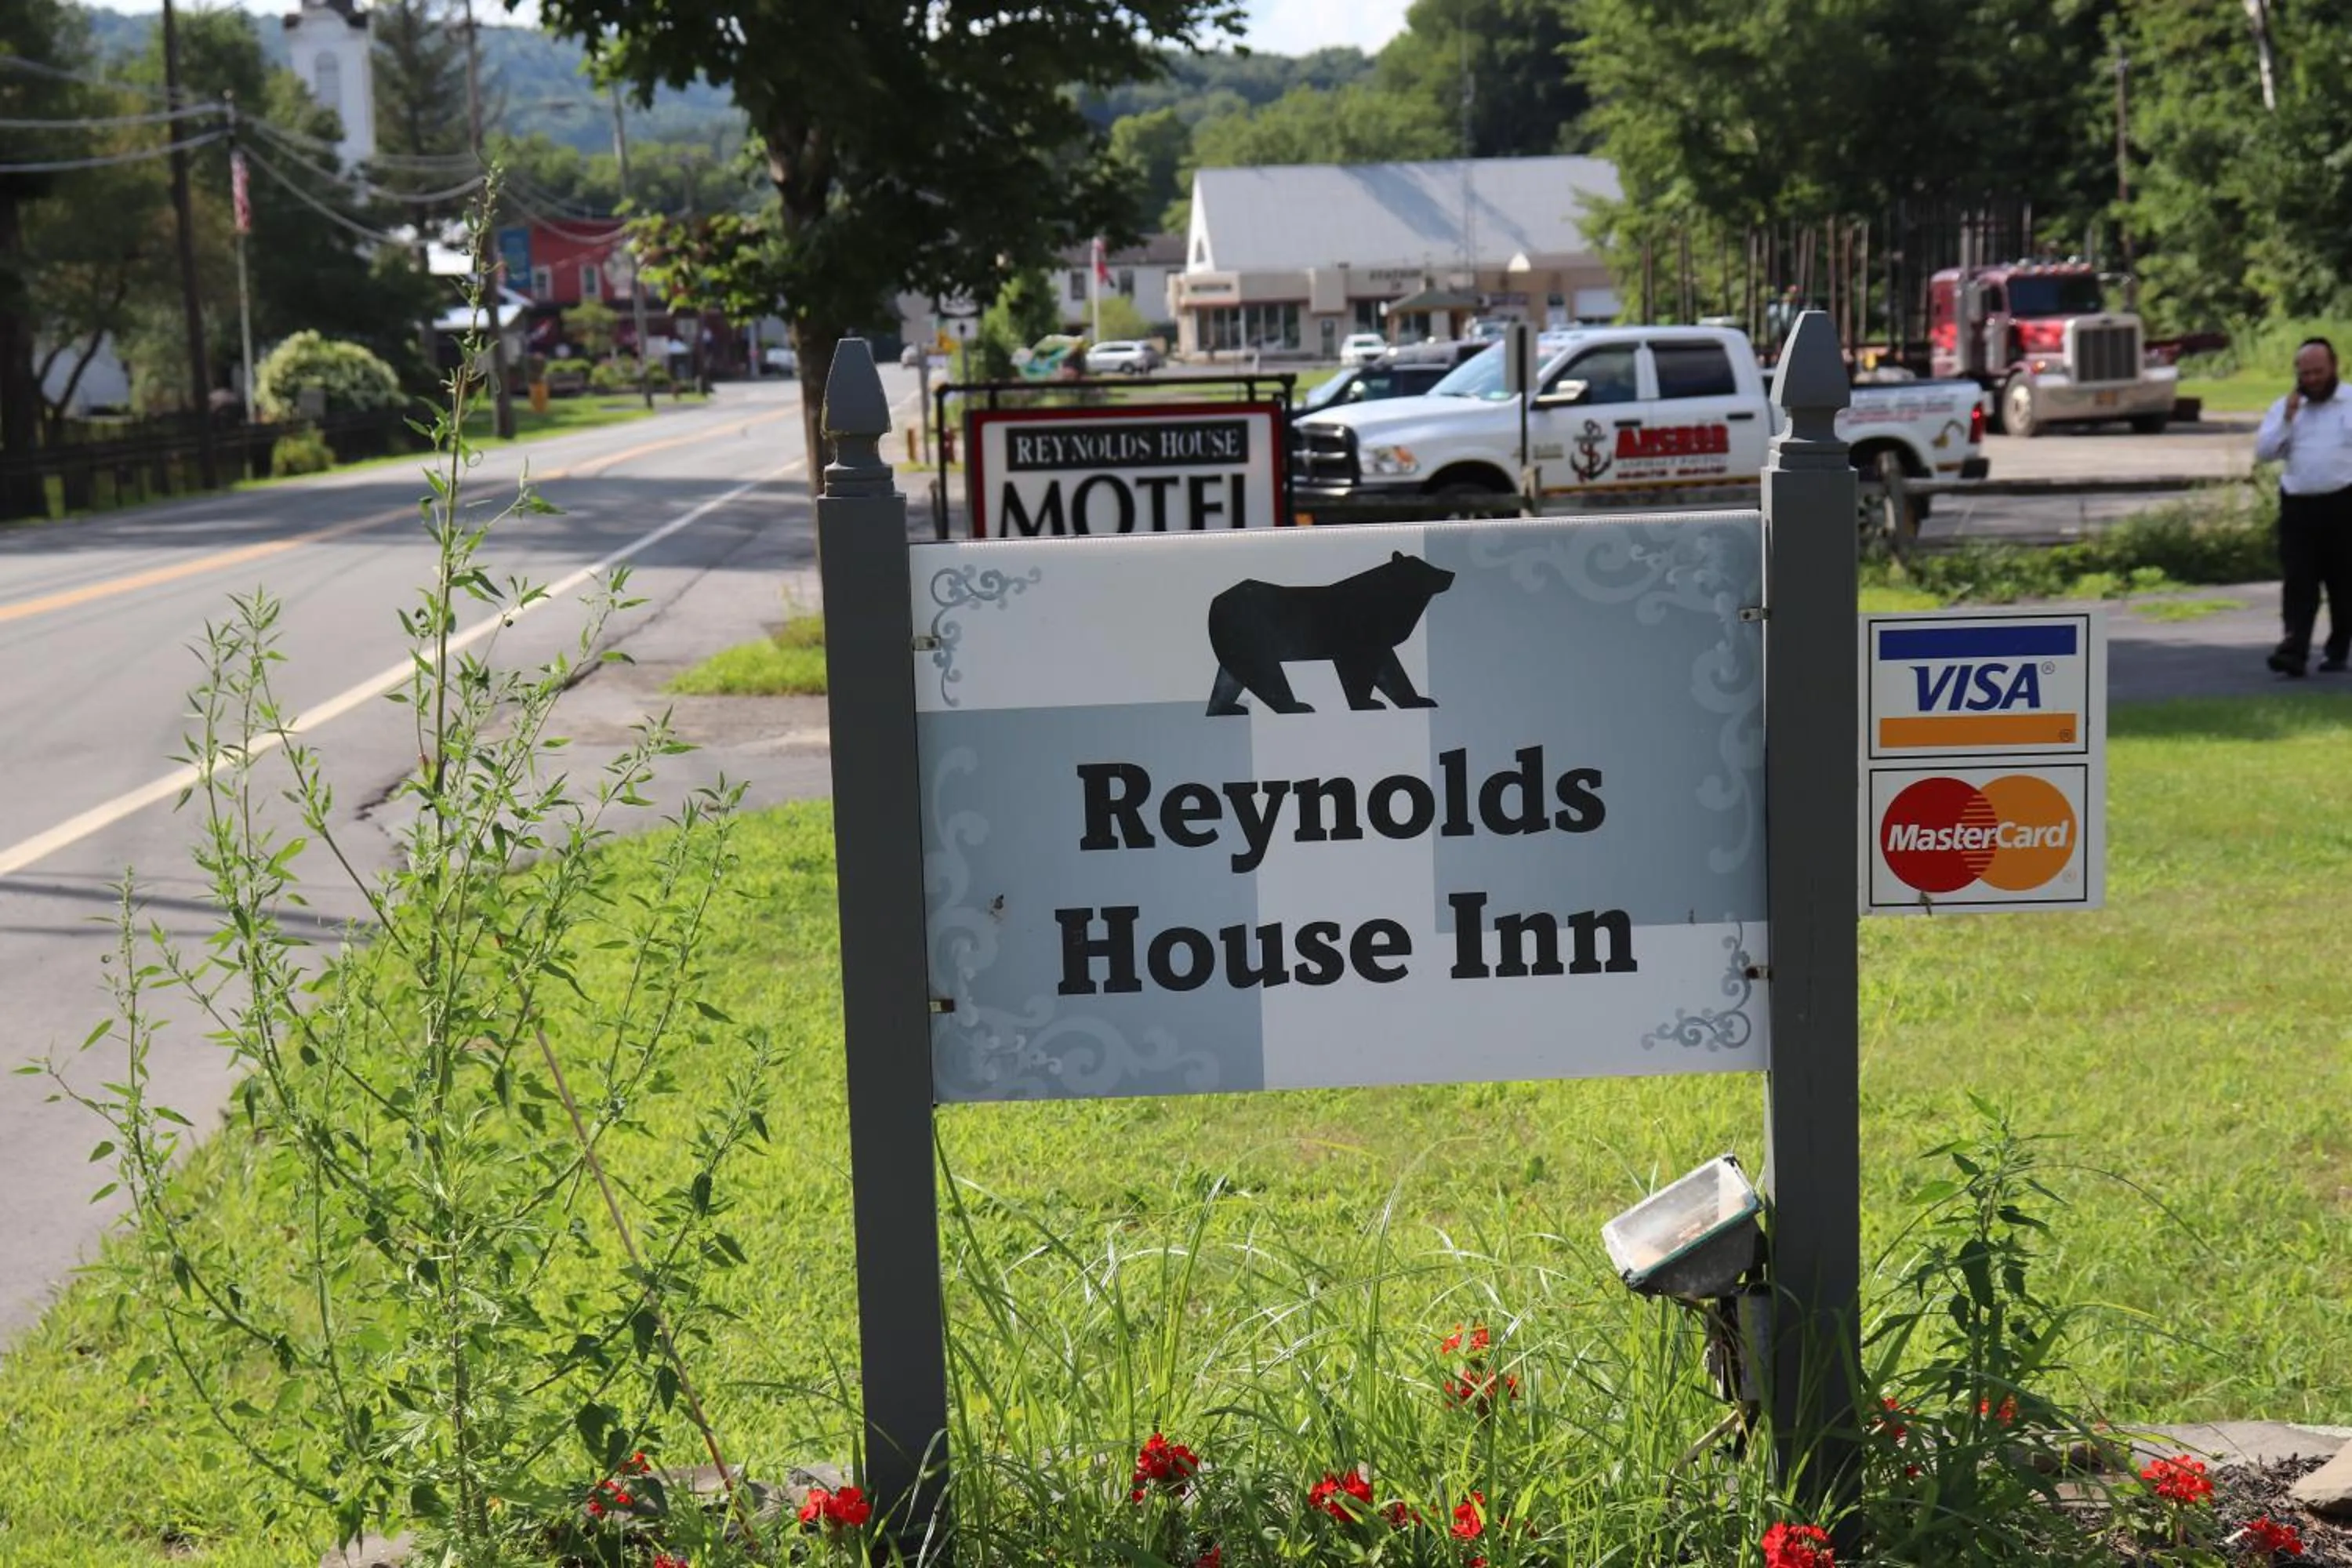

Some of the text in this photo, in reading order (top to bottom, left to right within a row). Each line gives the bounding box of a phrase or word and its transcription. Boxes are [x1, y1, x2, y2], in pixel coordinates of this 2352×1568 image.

[1015, 428, 1240, 464] REYNOLDS HOUSE
[1908, 662, 2042, 712] VISA
[1076, 745, 1606, 874] Reynolds
[1888, 820, 2069, 852] MasterCard
[1054, 892, 1638, 996] House Inn
